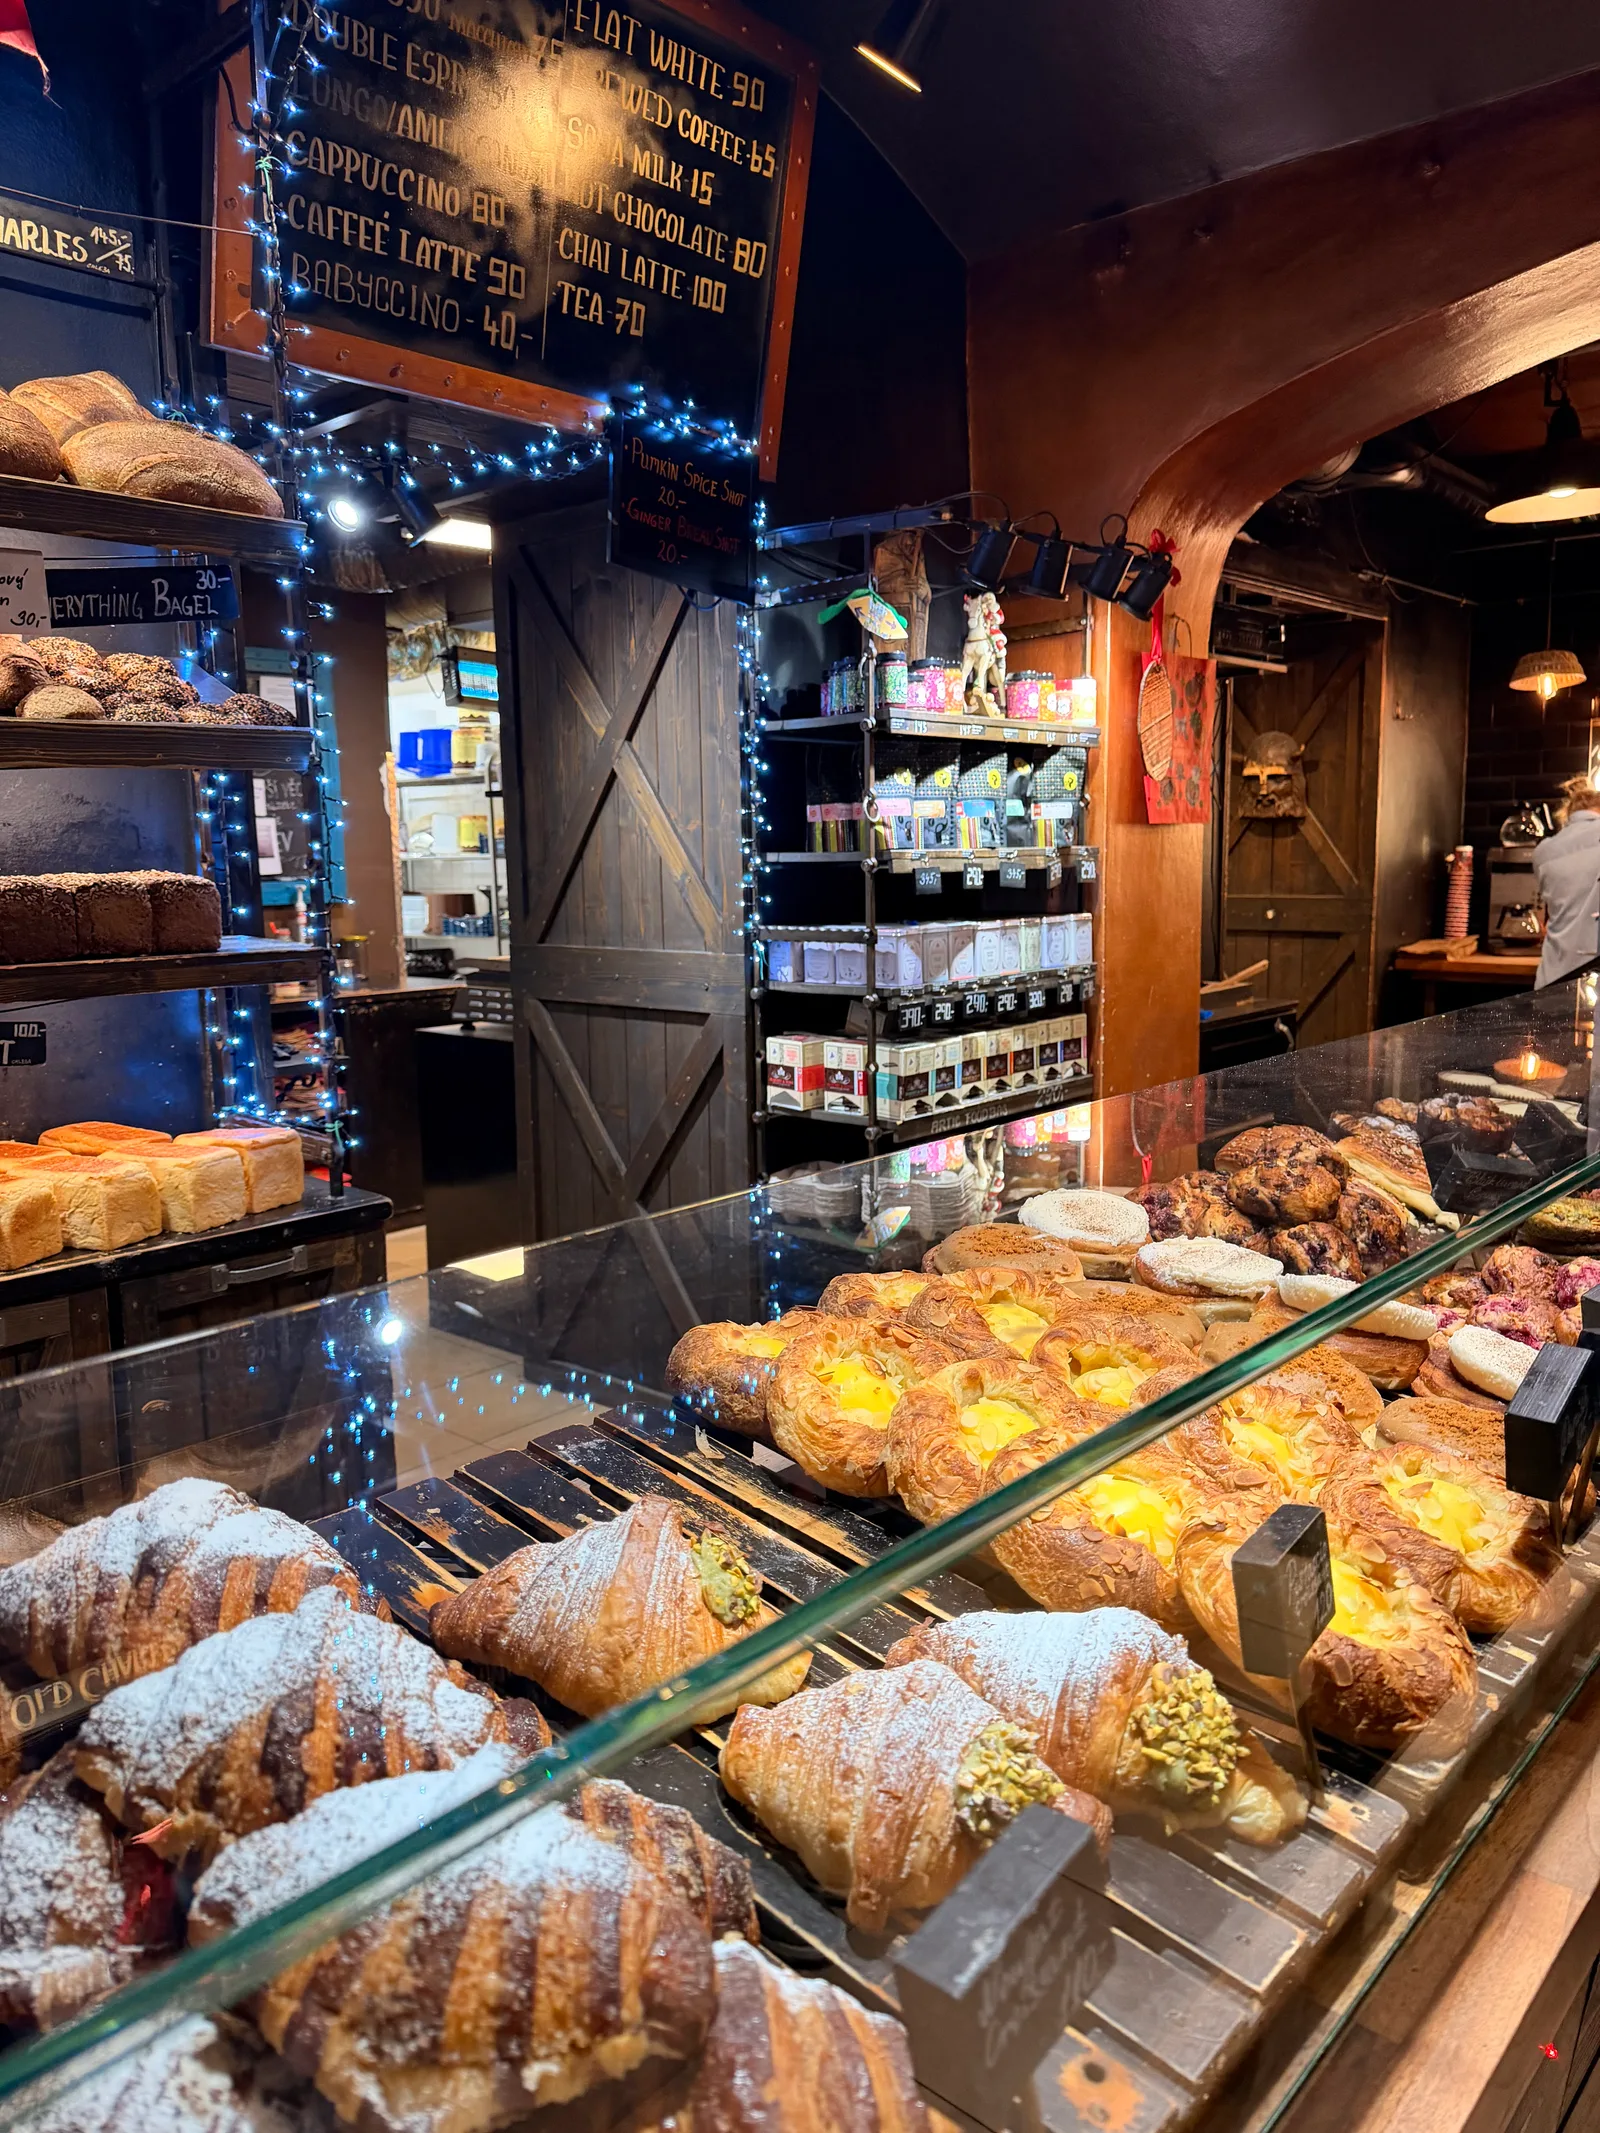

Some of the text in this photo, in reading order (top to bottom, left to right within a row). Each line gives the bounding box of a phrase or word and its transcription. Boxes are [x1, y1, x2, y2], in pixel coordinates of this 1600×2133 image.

[288, 0, 398, 71] DOUBLE
[573, 0, 765, 112] FLAT WHITE 90
[287, 130, 460, 217] CAPPUCCINO
[472, 191, 505, 227] 80
[567, 116, 624, 168] SOA
[632, 144, 684, 192] MILK
[690, 168, 716, 206] 15
[678, 108, 746, 165] COFFEE
[750, 139, 776, 178] 65
[0, 215, 88, 262] ARLES
[398, 228, 482, 283] LATTE
[487, 257, 526, 300] 90
[558, 227, 727, 314] CHAI LATTE 100
[613, 191, 729, 263] CHOCOLATE
[733, 237, 767, 279] 80
[291, 252, 460, 333] BABYCCINO
[556, 280, 646, 337] TEA 70
[626, 497, 672, 533] GINGER
